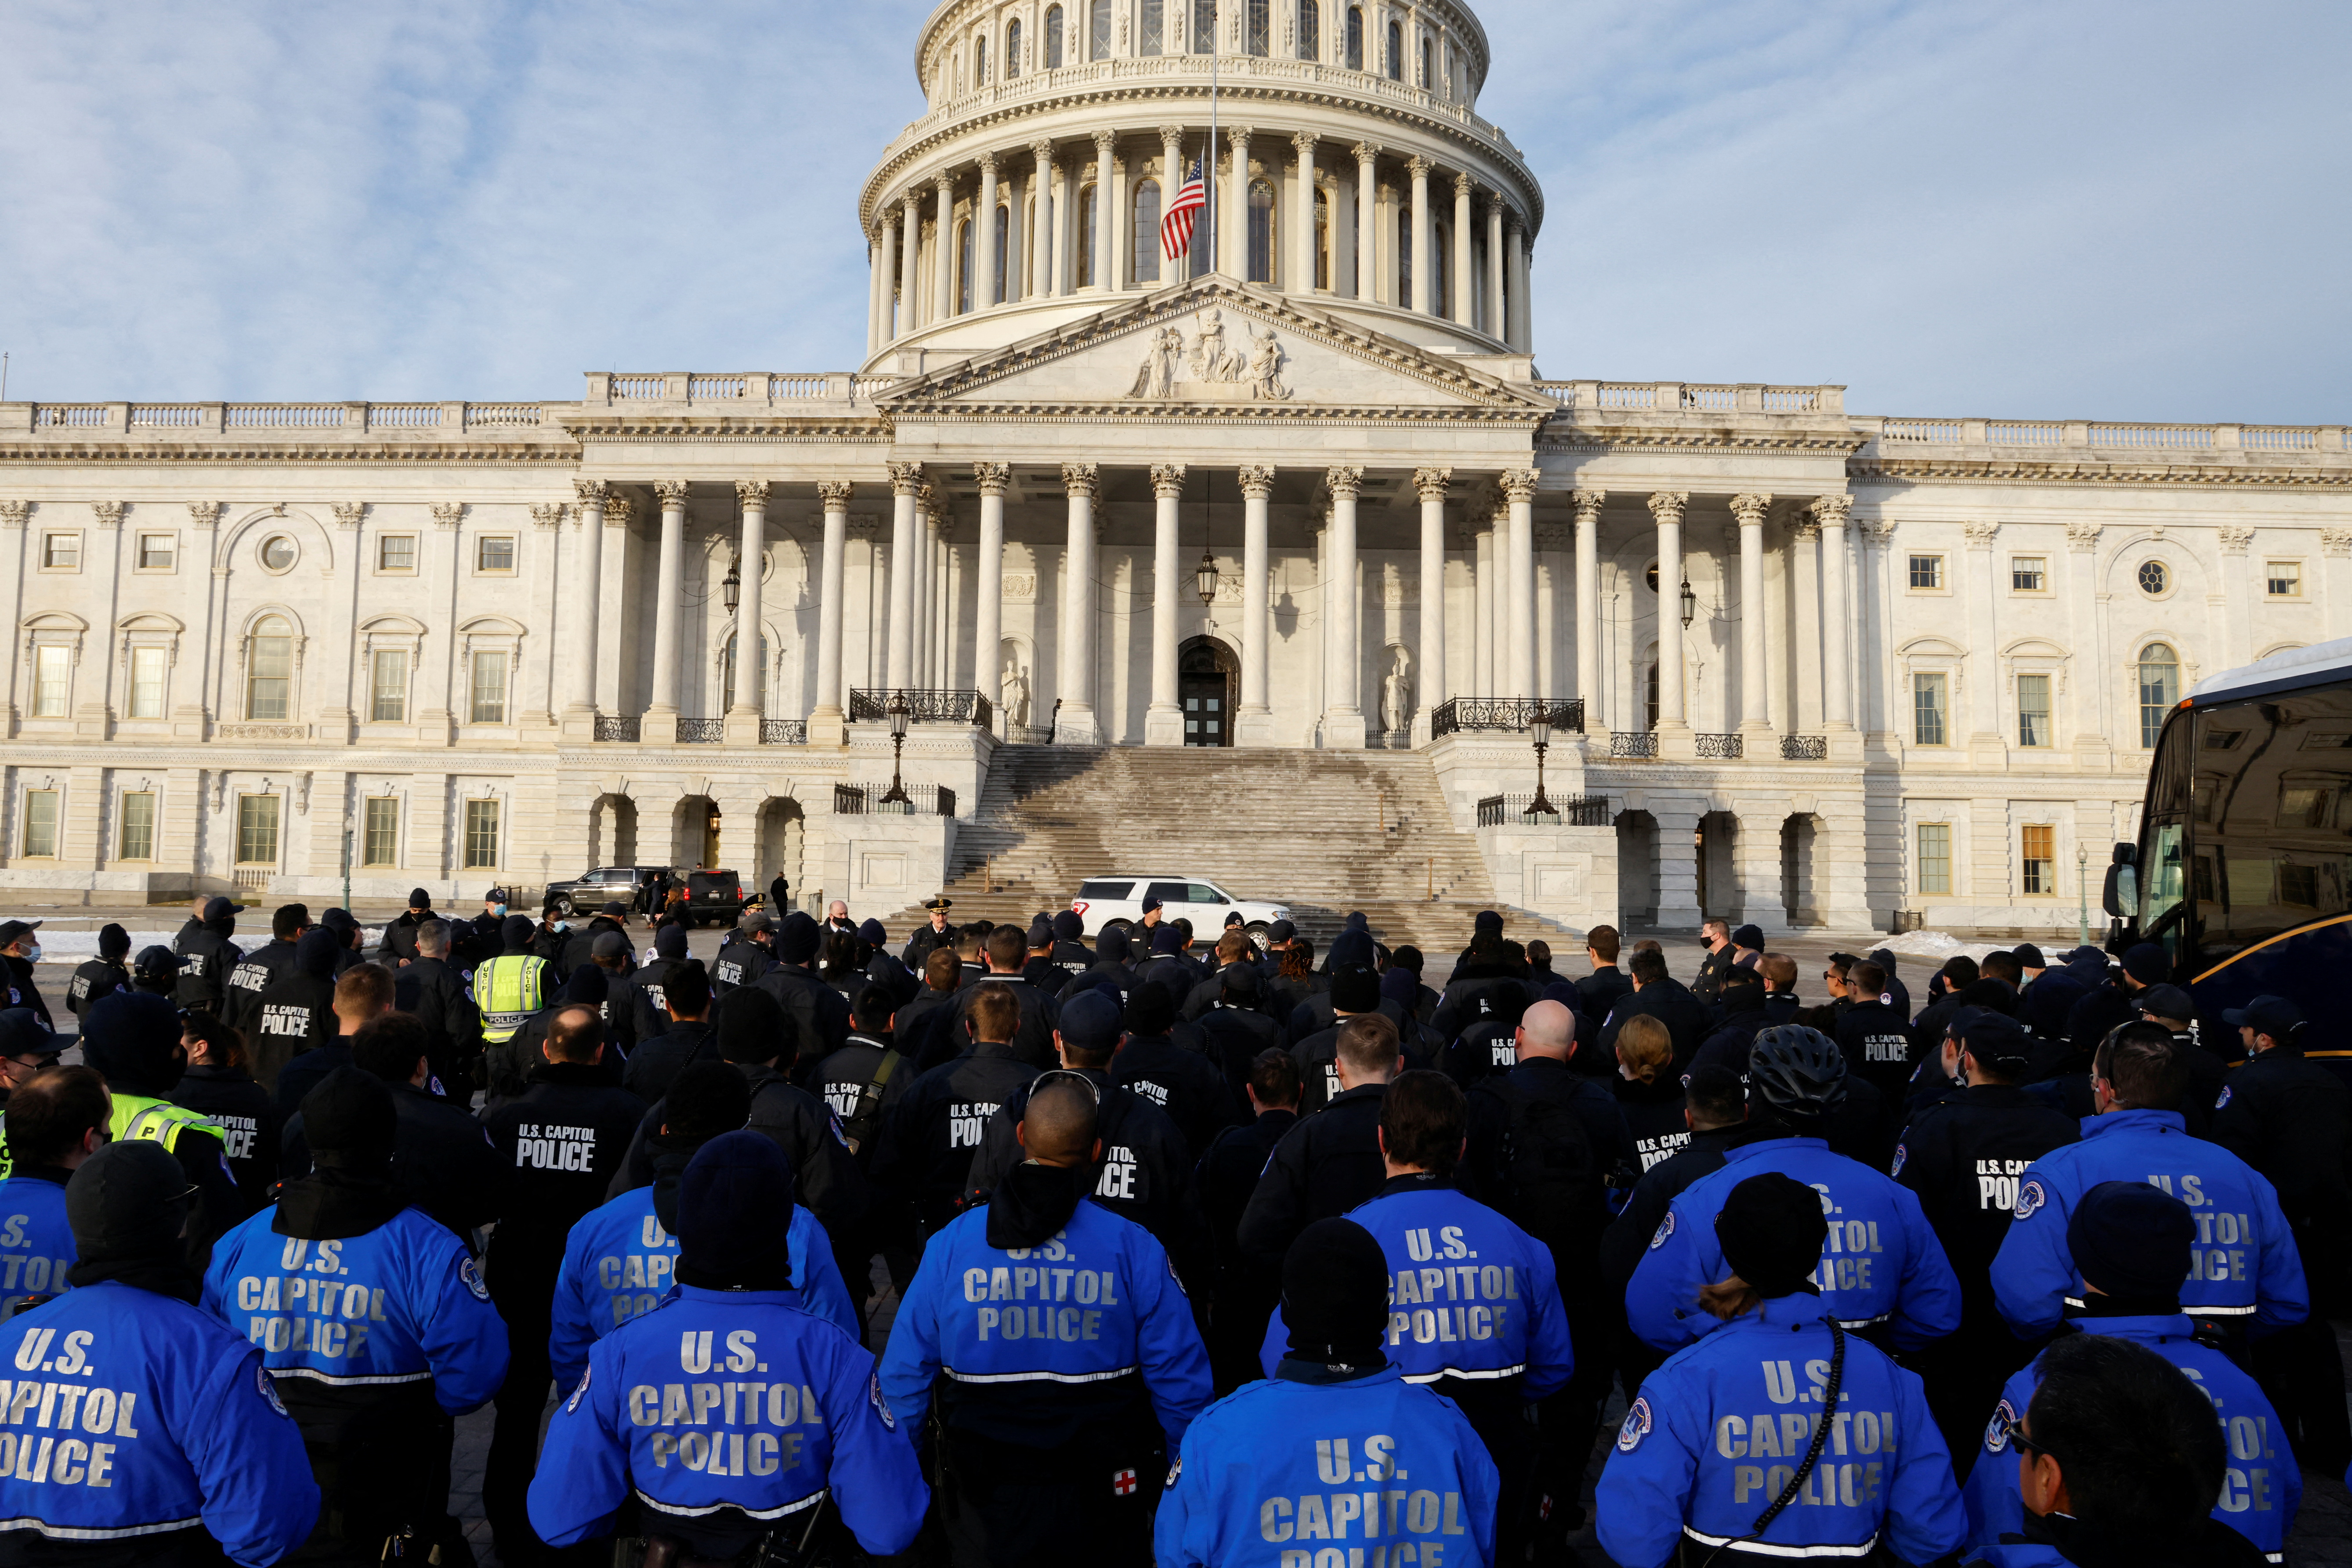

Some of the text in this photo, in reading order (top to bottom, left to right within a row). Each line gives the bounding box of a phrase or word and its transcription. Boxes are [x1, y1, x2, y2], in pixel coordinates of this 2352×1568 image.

[228, 969, 267, 992] POLICE
[246, 963, 269, 975] CAPITOL
[716, 966, 742, 985] POLICE
[726, 961, 742, 972] CAPITOL
[260, 1014, 310, 1038] POLICE
[264, 1004, 310, 1018] U.S. CAPITOL
[488, 1015, 525, 1024] POLICE
[1491, 1038, 1506, 1047] U.S.
[1864, 1035, 1908, 1044] U.S. CAPITOL
[1865, 1043, 1908, 1062] POLICE
[825, 1083, 862, 1096] U.S. CAPI
[950, 1104, 971, 1118] U.S.
[223, 1129, 257, 1159] ICE
[519, 1123, 596, 1142] U.S. CAPITOL
[1636, 1131, 1691, 1153] U.S. CAPIT
[516, 1138, 596, 1172] POLICE
[1976, 1159, 2004, 1175] U.S.
[1095, 1162, 1137, 1199] ICE
[2148, 1175, 2213, 1206] US.
[0, 1214, 32, 1248] S.
[1405, 1226, 1477, 1262] U.S.
[281, 1237, 348, 1275] U.S.
[599, 1254, 680, 1290] CAPI
[2186, 1249, 2246, 1281] ICE
[237, 1276, 387, 1322] CAPITOL
[963, 1267, 1118, 1305] CAPITOL
[250, 1317, 369, 1358] POLICE
[977, 1306, 1102, 1342] POLICE
[1387, 1306, 1507, 1346] POLICE
[14, 1328, 94, 1376] U.S.
[680, 1330, 768, 1374] U.S.
[1761, 1359, 1849, 1404] U.S.
[0, 1380, 138, 1439] APITOL
[629, 1381, 823, 1427] CAPITOL
[1716, 1411, 1897, 1459] CAPITOL
[0, 1432, 116, 1488] OLICE
[651, 1431, 804, 1477] POLICE
[1316, 1434, 1408, 1485] U.S.
[1734, 1462, 1883, 1507] POLICE
[1260, 1489, 1465, 1543] CAPITOL
